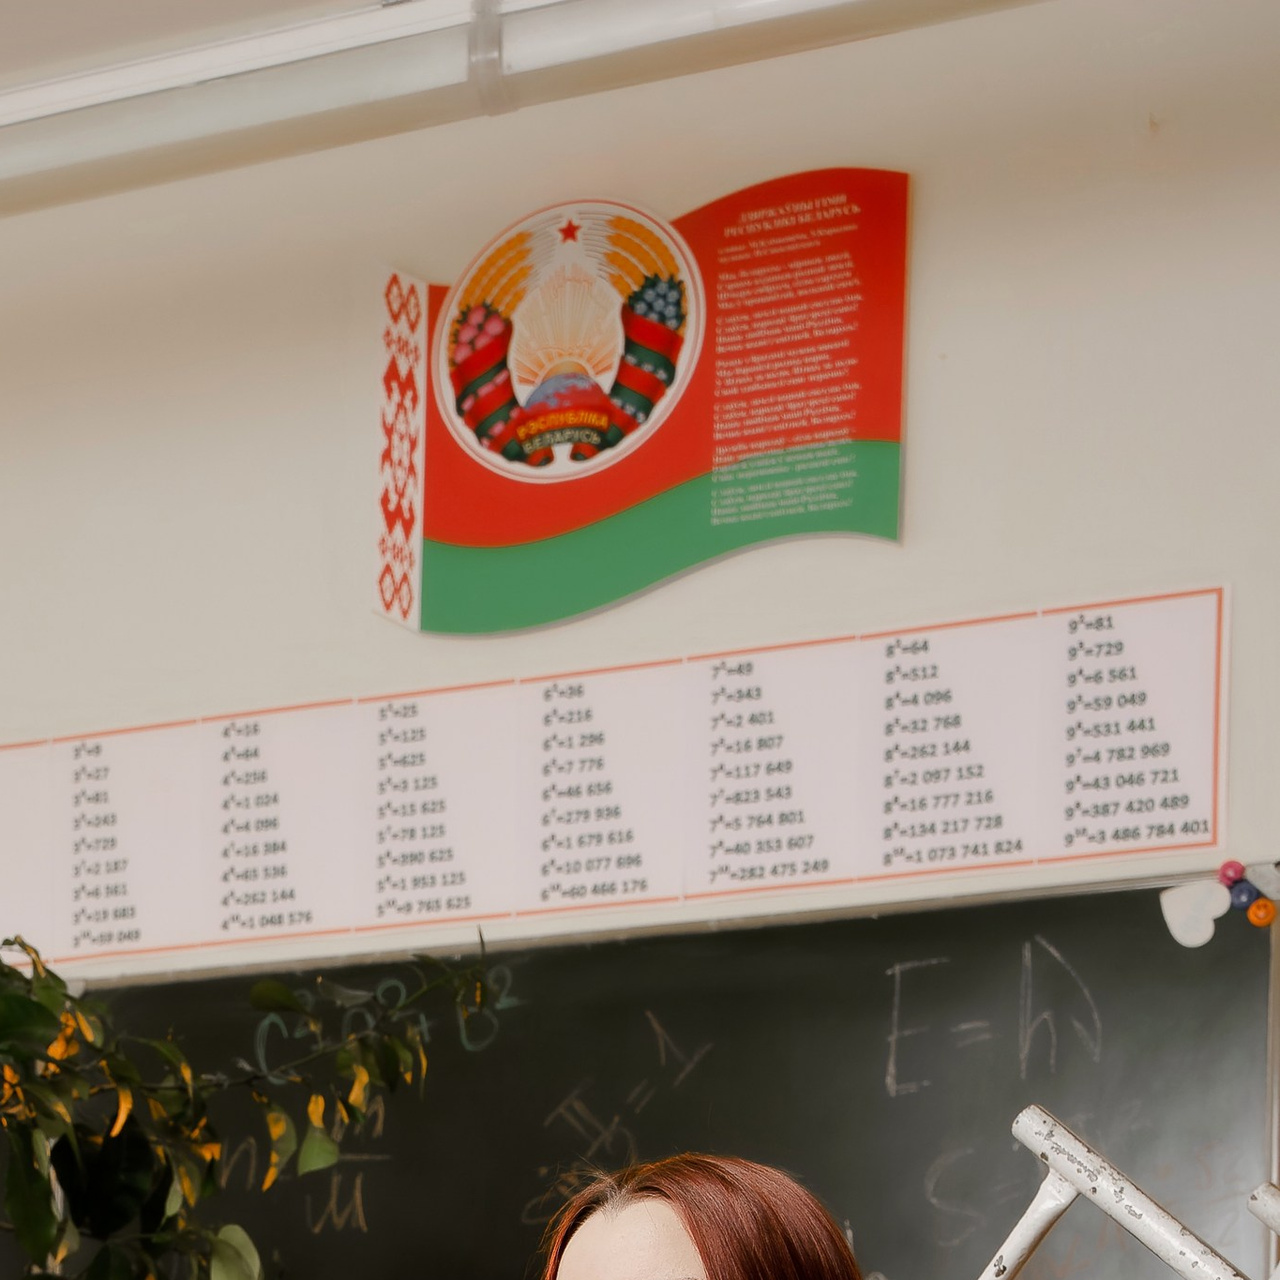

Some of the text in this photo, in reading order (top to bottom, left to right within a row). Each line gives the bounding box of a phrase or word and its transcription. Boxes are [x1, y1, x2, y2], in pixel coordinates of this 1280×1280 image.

[1108, 666, 1136, 683] 561
[923, 689, 952, 706] 096
[1117, 692, 1147, 708] 049
[933, 714, 962, 730] 768
[1126, 718, 1155, 733] 441
[943, 740, 970, 756] 144
[1106, 747, 1135, 762] 782
[1140, 743, 1170, 759] 969
[922, 768, 951, 784] 097
[956, 764, 984, 781] 152
[1115, 773, 1145, 788] 046
[1150, 769, 1179, 785] 721
[932, 793, 960, 809] 777
[965, 790, 994, 806] 216
[1124, 799, 1155, 813] 420
[1159, 795, 1190, 810] 489
[941, 818, 970, 835] 217
[975, 815, 1003, 831] 728
[1111, 827, 1141, 841] 486
[1146, 823, 1175, 839] 784
[1180, 820, 1209, 834] 401
[927, 846, 957, 862] 073
[962, 843, 988, 857] 741
[994, 840, 1023, 855] 824
